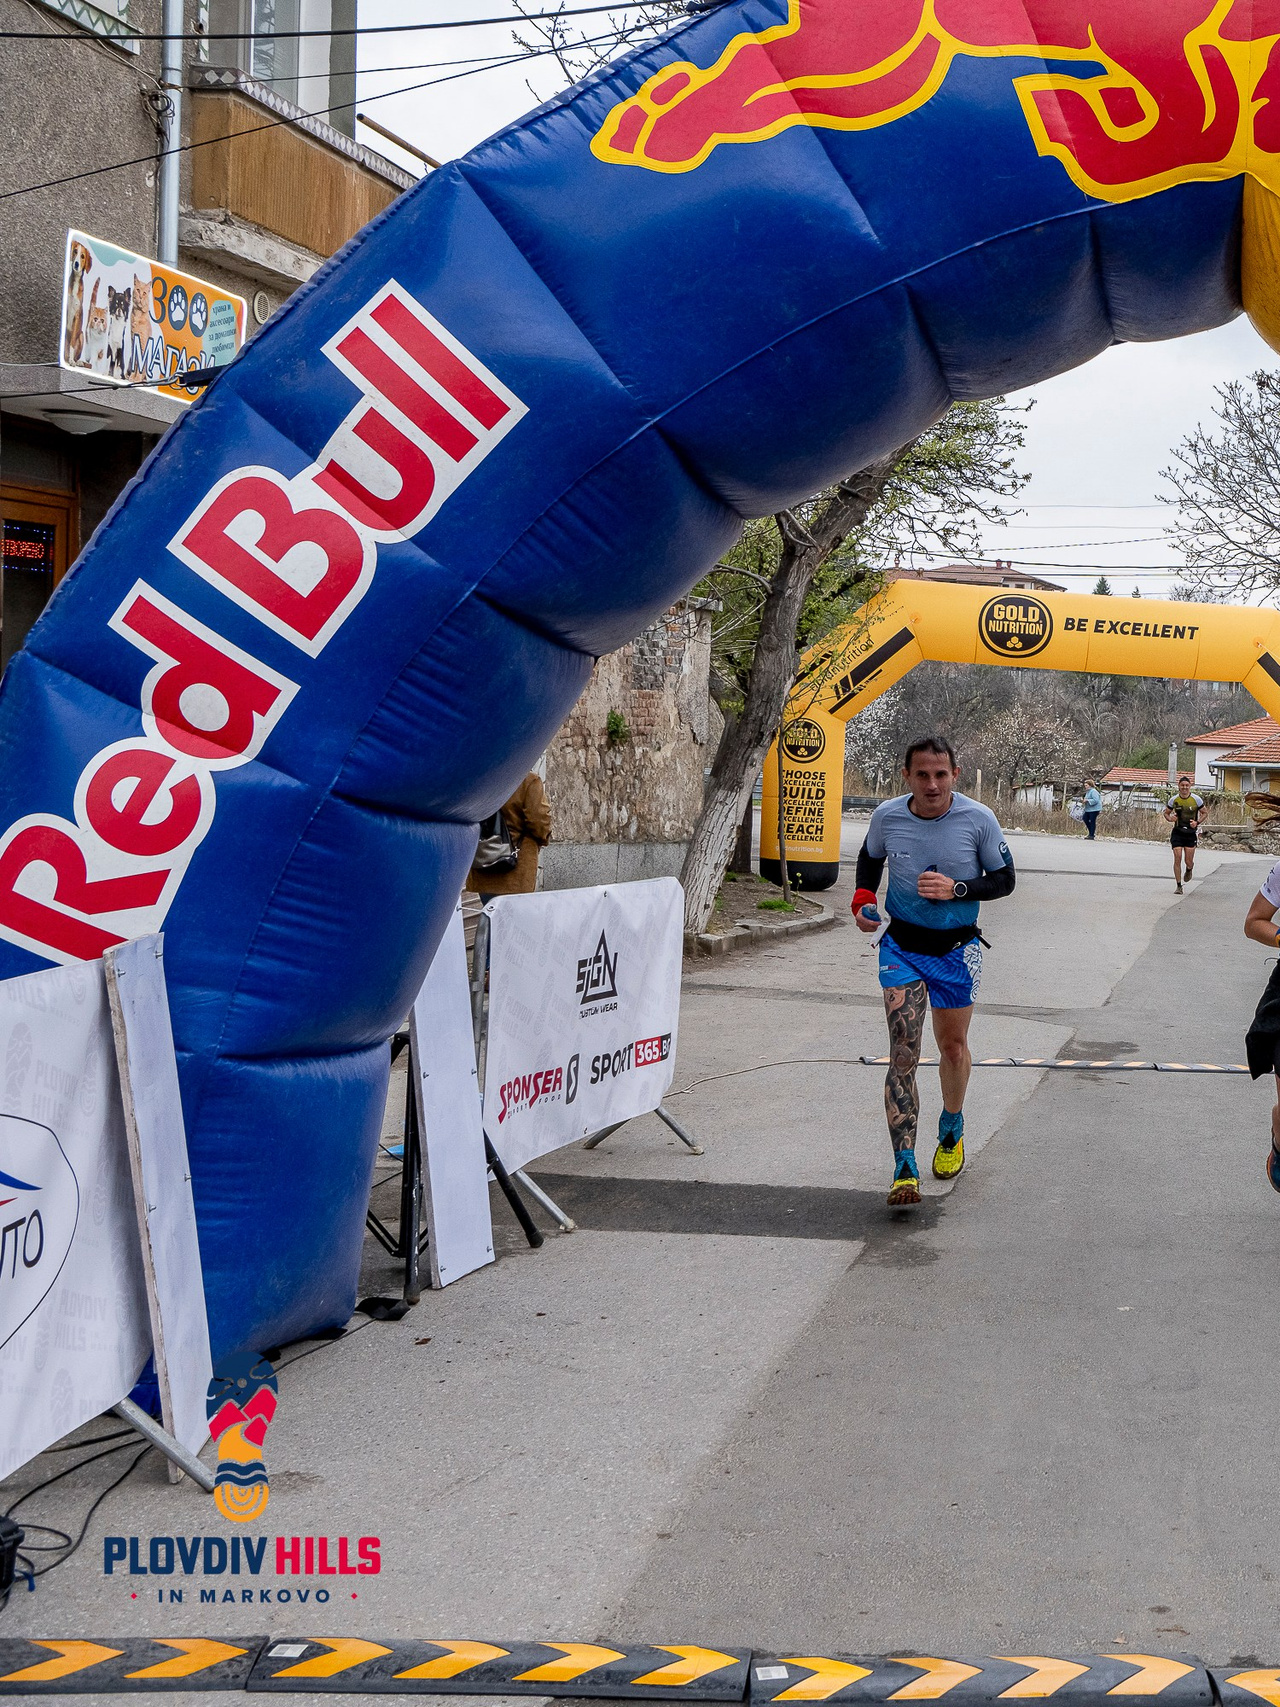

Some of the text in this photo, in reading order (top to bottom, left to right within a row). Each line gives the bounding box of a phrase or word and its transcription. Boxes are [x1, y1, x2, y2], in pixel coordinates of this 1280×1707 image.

[993, 604, 1040, 623] GOLD
[0, 290, 518, 966] Red Bull
[988, 620, 1043, 636] NUTRITION
[1064, 617, 1199, 640] BE EXCELLENT
[783, 799, 825, 807] XCELLENCE
[600, 1002, 618, 1014] WEAR
[498, 1066, 563, 1124] SPONSER
